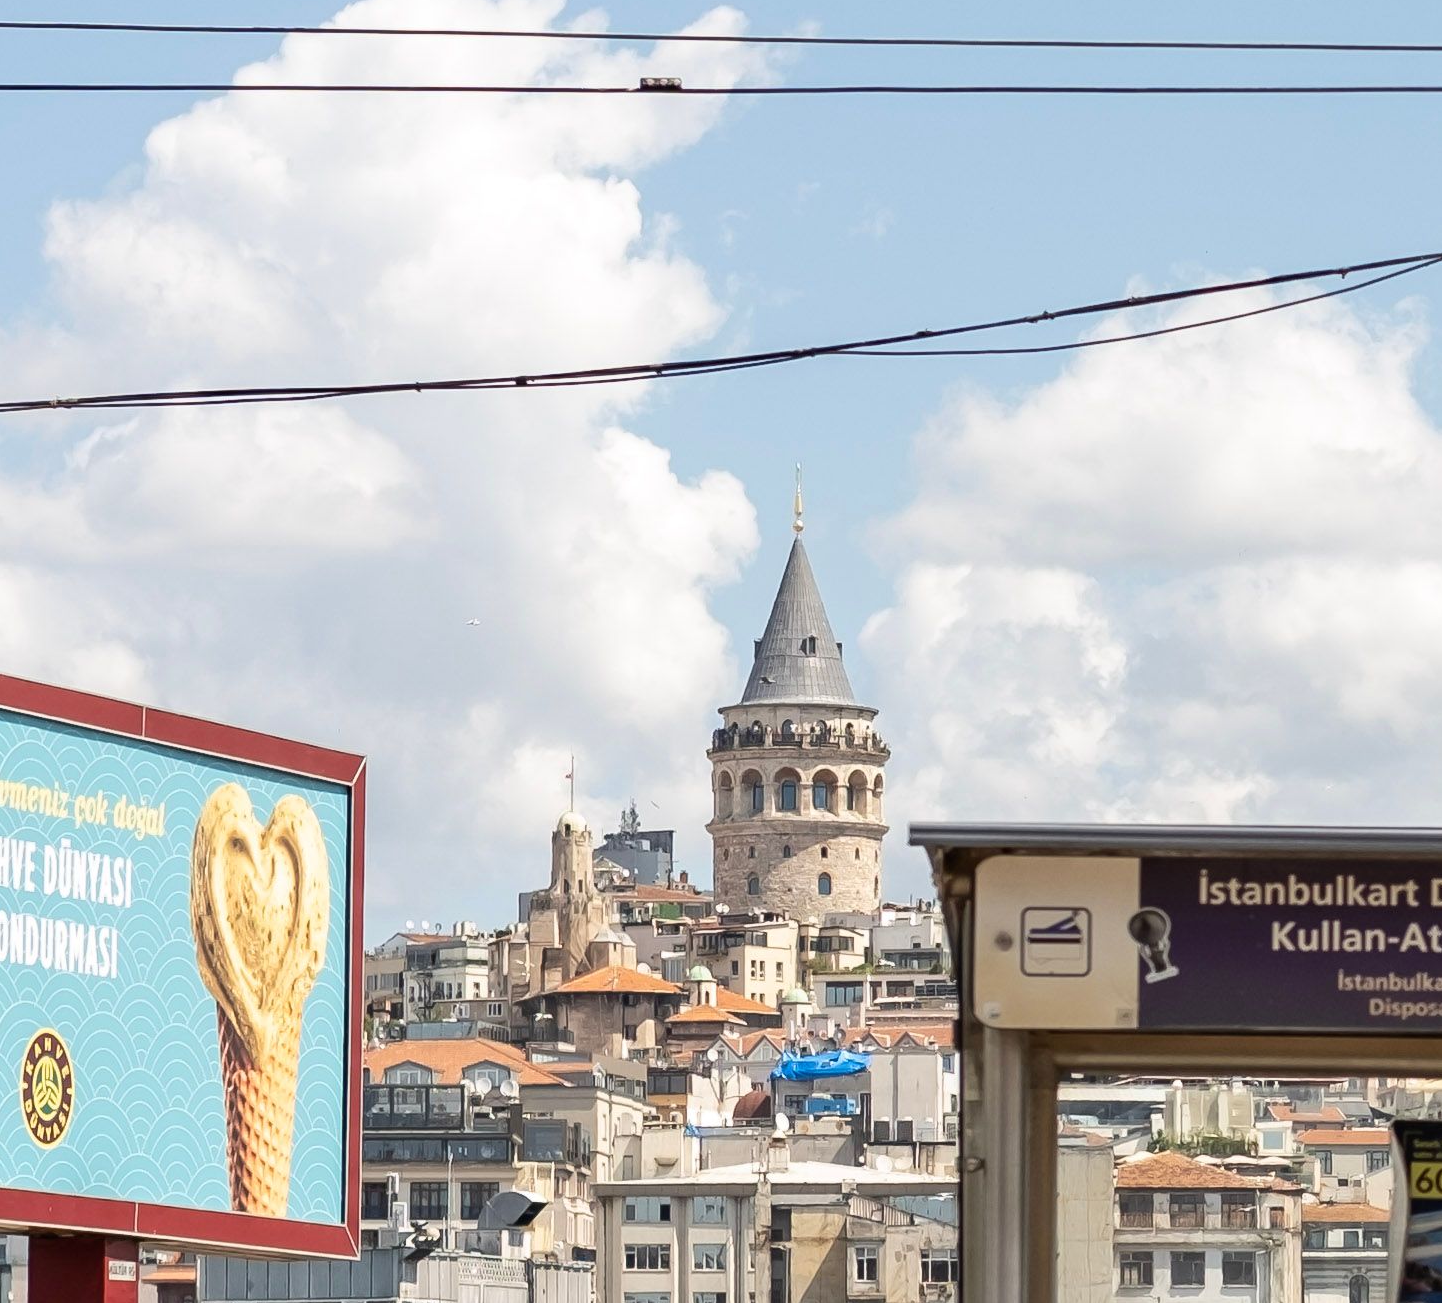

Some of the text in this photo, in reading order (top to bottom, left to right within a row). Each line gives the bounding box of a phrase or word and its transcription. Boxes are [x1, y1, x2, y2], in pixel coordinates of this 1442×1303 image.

[74, 795, 109, 829] çok
[114, 800, 165, 840] doğal
[44, 840, 133, 908] DÜNYASI
[1199, 868, 1419, 907] İstanbulkart
